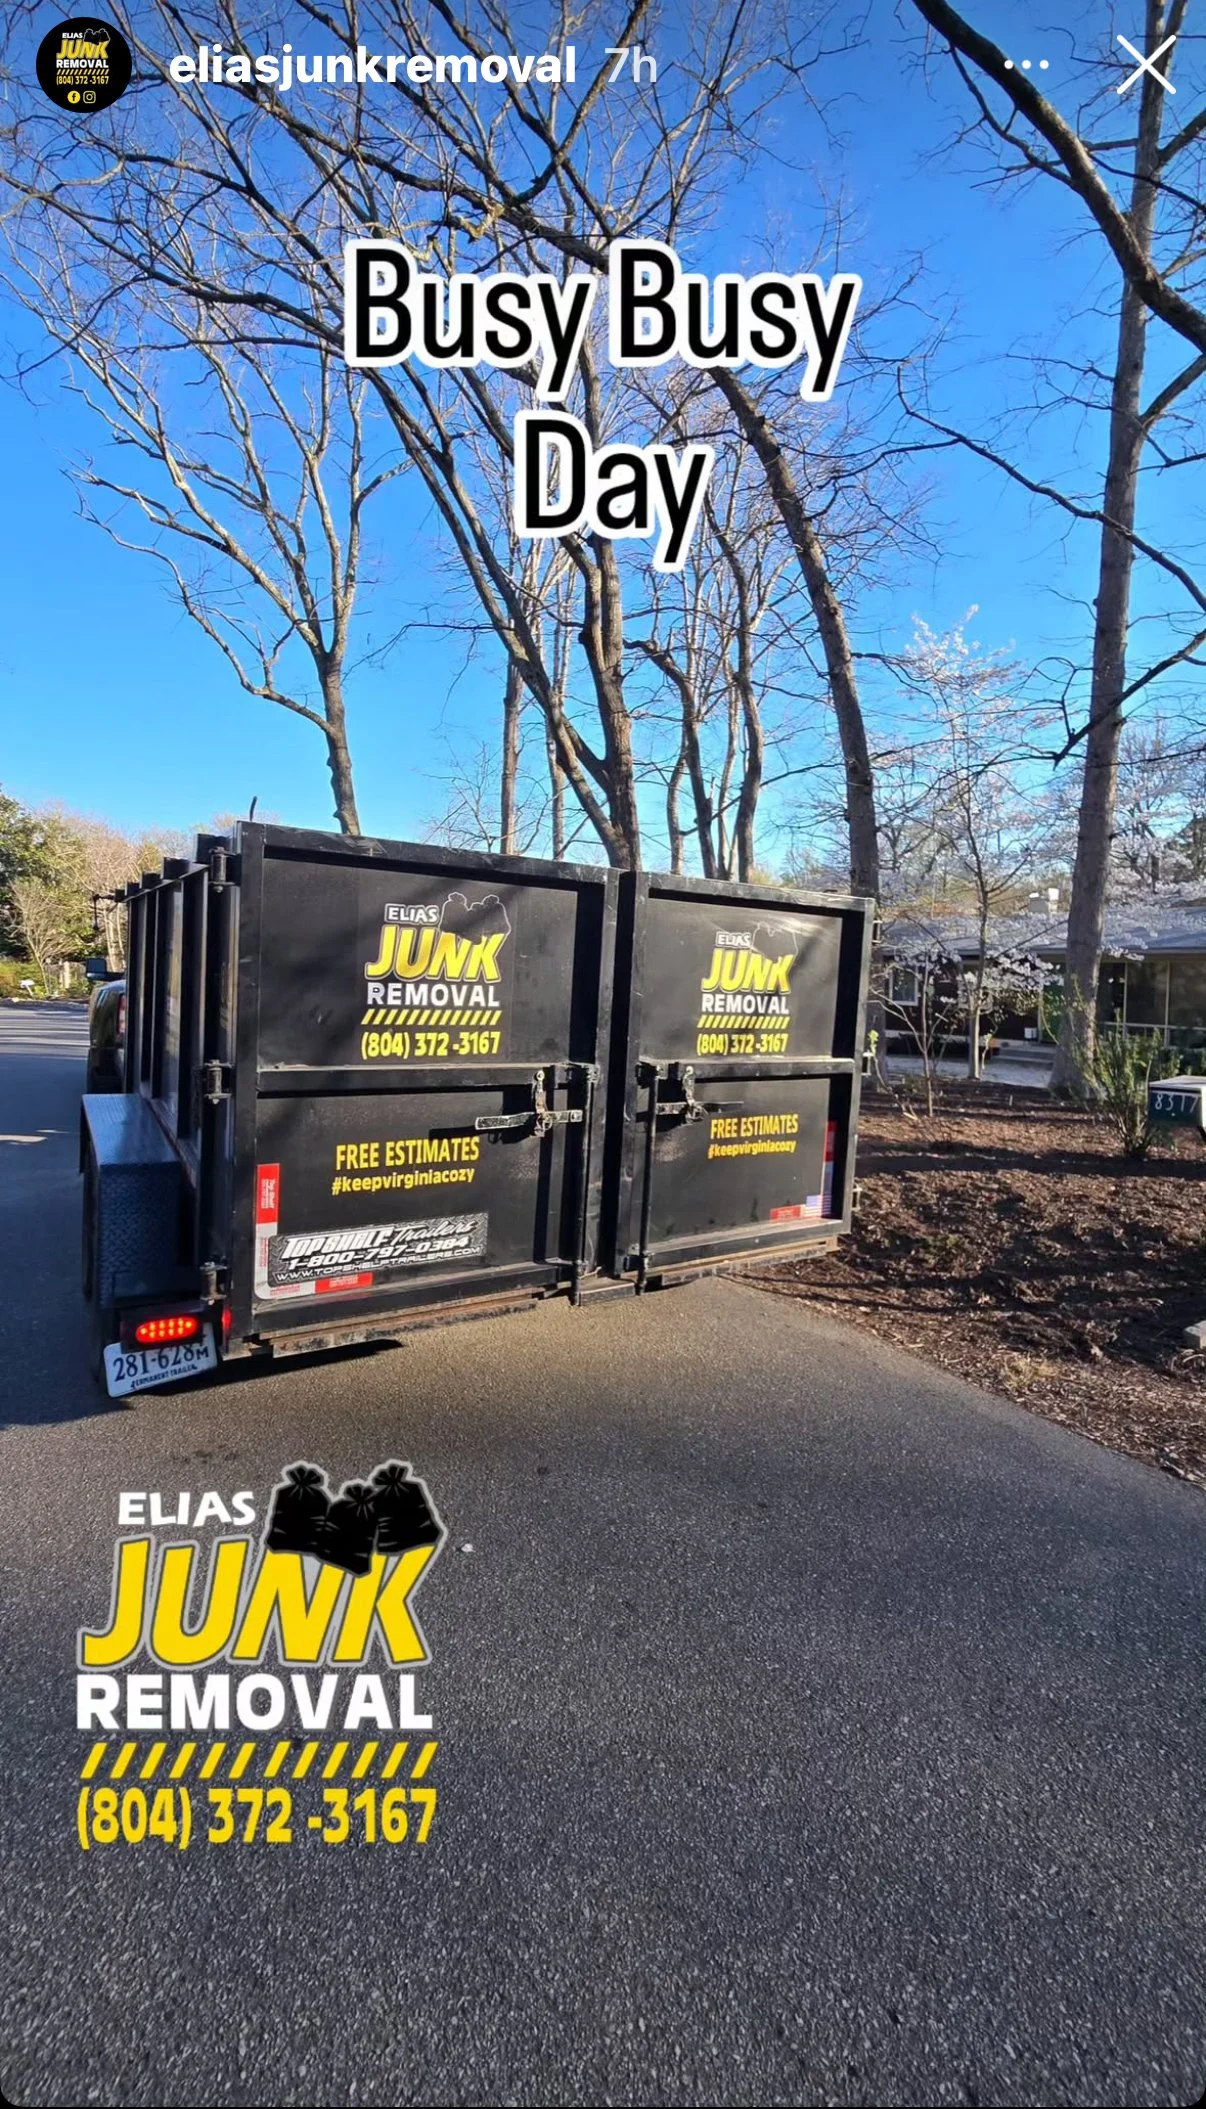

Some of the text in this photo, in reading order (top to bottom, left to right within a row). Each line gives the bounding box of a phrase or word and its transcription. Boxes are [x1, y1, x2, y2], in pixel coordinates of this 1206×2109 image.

[386, 906, 439, 924] ELIAS
[717, 932, 752, 947] ELIAS
[365, 924, 505, 982] JUNK
[702, 948, 795, 994] JUNK
[366, 982, 501, 1007] REMOVAL
[702, 993, 790, 1014] REMOVAL
[361, 1031, 501, 1060] (804) 372 -3167
[697, 1033, 789, 1056] (804) 372 -3167
[710, 1113, 799, 1139] FREE ESTIMATES
[336, 1135, 480, 1171] FREE ESTIMATES
[708, 1140, 797, 1159] #keepvirginiacozy
[332, 1167, 475, 1196] #keepvirginiacozy
[390, 1220, 478, 1246] Trailers
